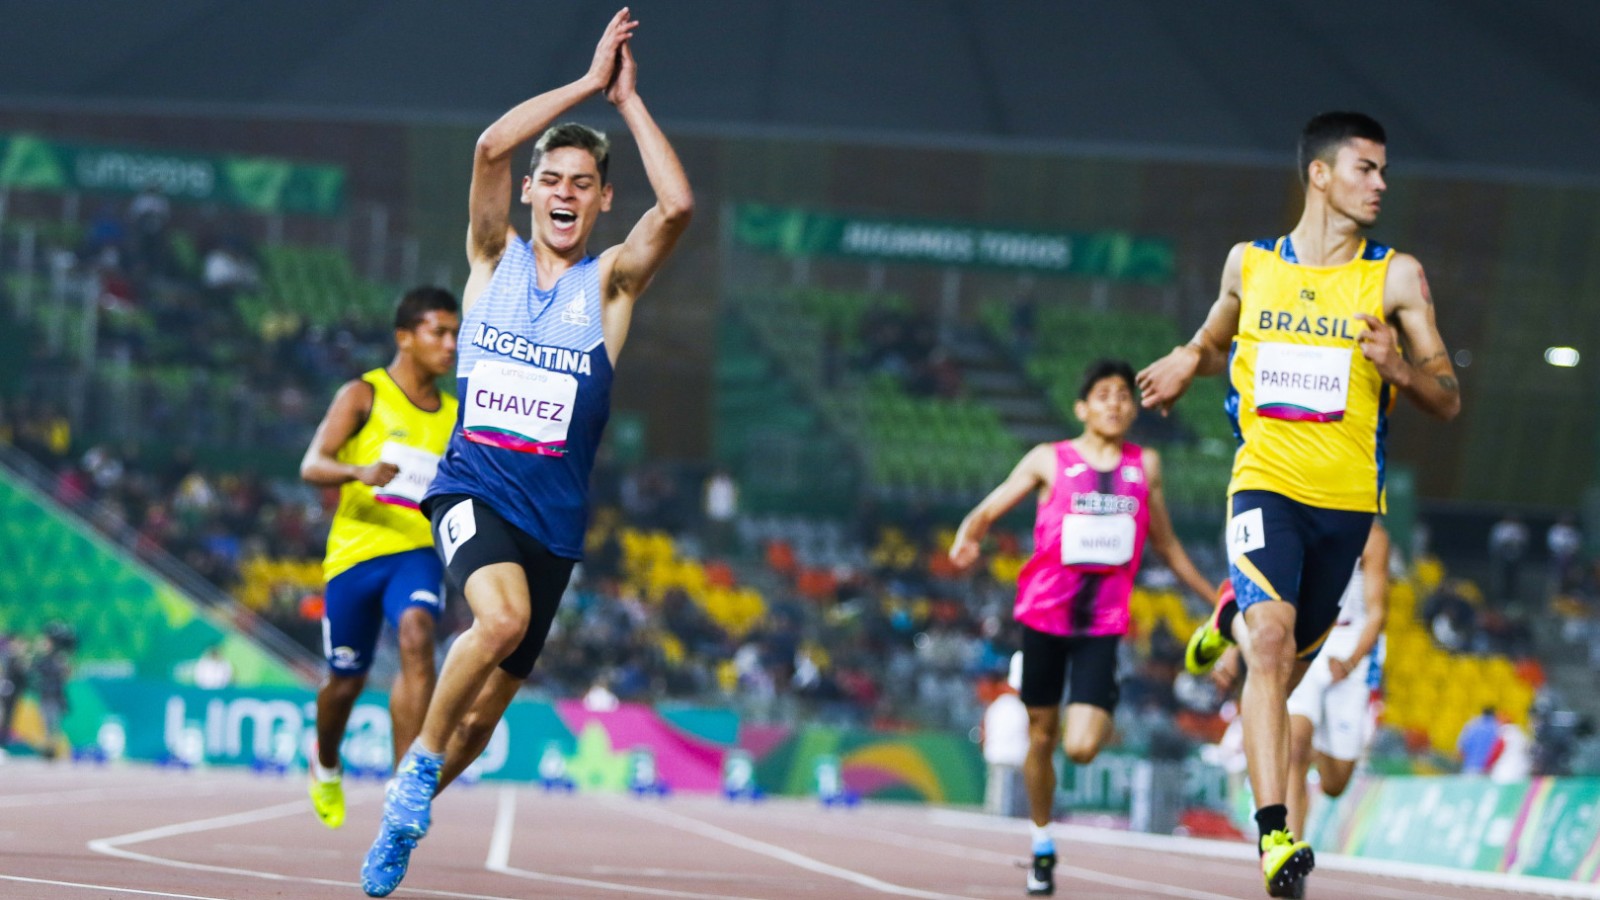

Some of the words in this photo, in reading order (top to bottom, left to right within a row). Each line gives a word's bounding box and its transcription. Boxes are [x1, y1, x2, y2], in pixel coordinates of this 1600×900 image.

[1259, 311, 1355, 340] BRASIL
[472, 323, 592, 376] ARGENTINA
[1261, 370, 1342, 393] PARREIRA
[475, 389, 565, 422] CHAVEZ
[1234, 524, 1251, 544] 4
